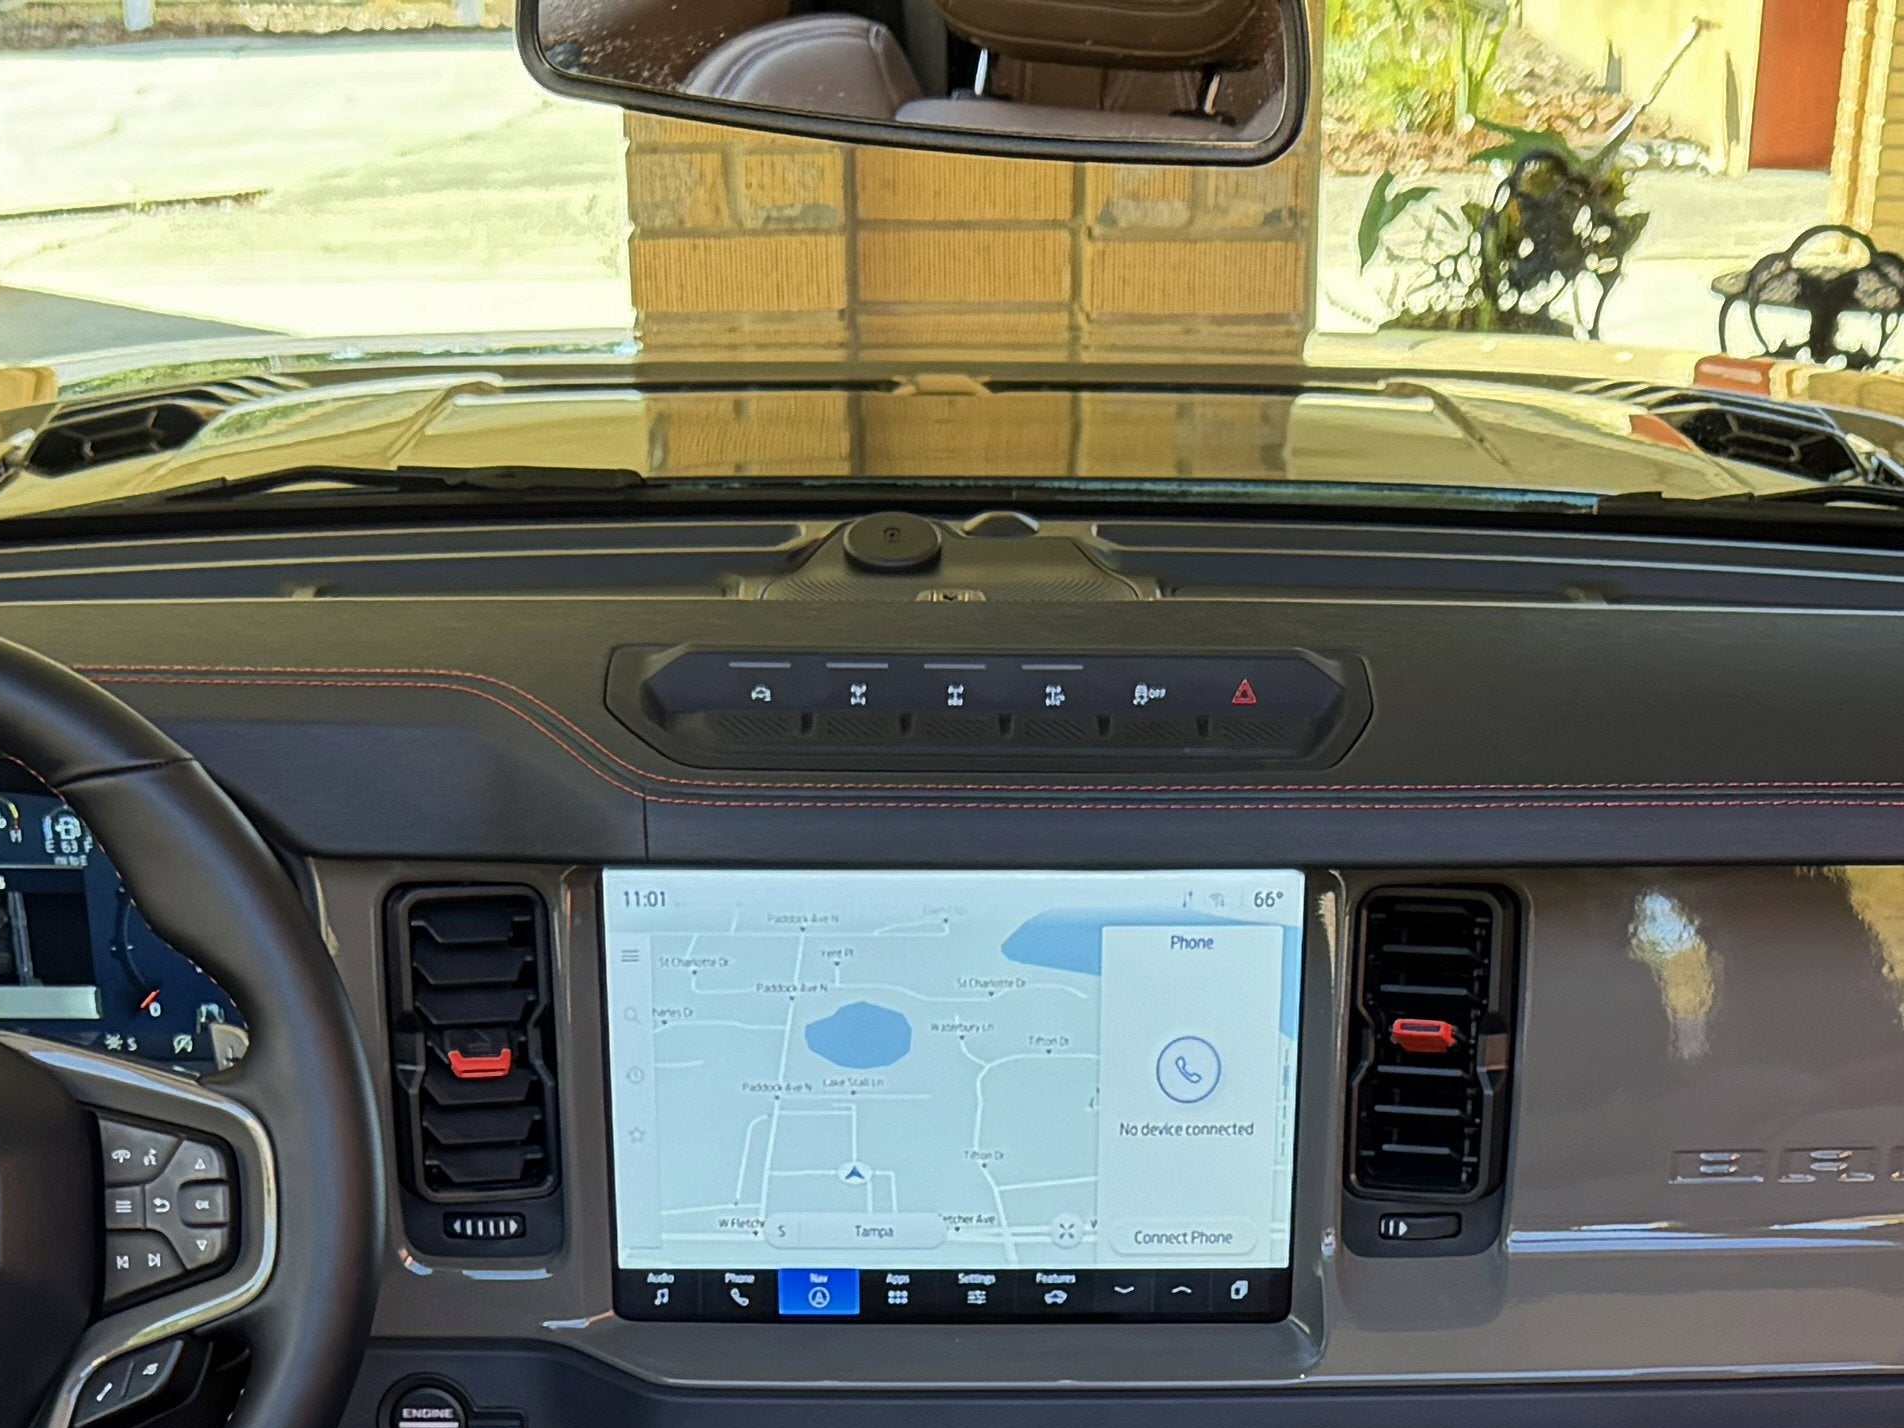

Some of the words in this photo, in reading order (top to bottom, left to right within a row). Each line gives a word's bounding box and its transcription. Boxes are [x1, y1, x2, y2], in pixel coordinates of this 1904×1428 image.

[623, 890, 667, 908] 11:01
[1254, 891, 1284, 908] 66°
[1170, 935, 1214, 950] Phone
[757, 983, 795, 994] Paddock
[819, 983, 828, 993] N
[149, 1002, 161, 1017] 0
[1120, 1123, 1138, 1136] No
[1141, 1122, 1183, 1136] device
[1185, 1122, 1254, 1136] connected
[718, 1219, 729, 1228] W
[976, 1214, 995, 1224] Ave
[778, 1225, 786, 1238] S
[855, 1226, 894, 1239] Tampa
[1134, 1231, 1187, 1245] Connect
[1191, 1230, 1233, 1245] Phone
[647, 1272, 675, 1284] Audio
[725, 1272, 755, 1284] Phone
[809, 1272, 828, 1283] Nav
[886, 1273, 910, 1285] Apps
[958, 1272, 996, 1286] Settings
[1036, 1272, 1076, 1284] Features
[402, 1408, 454, 1419] ENGINE
